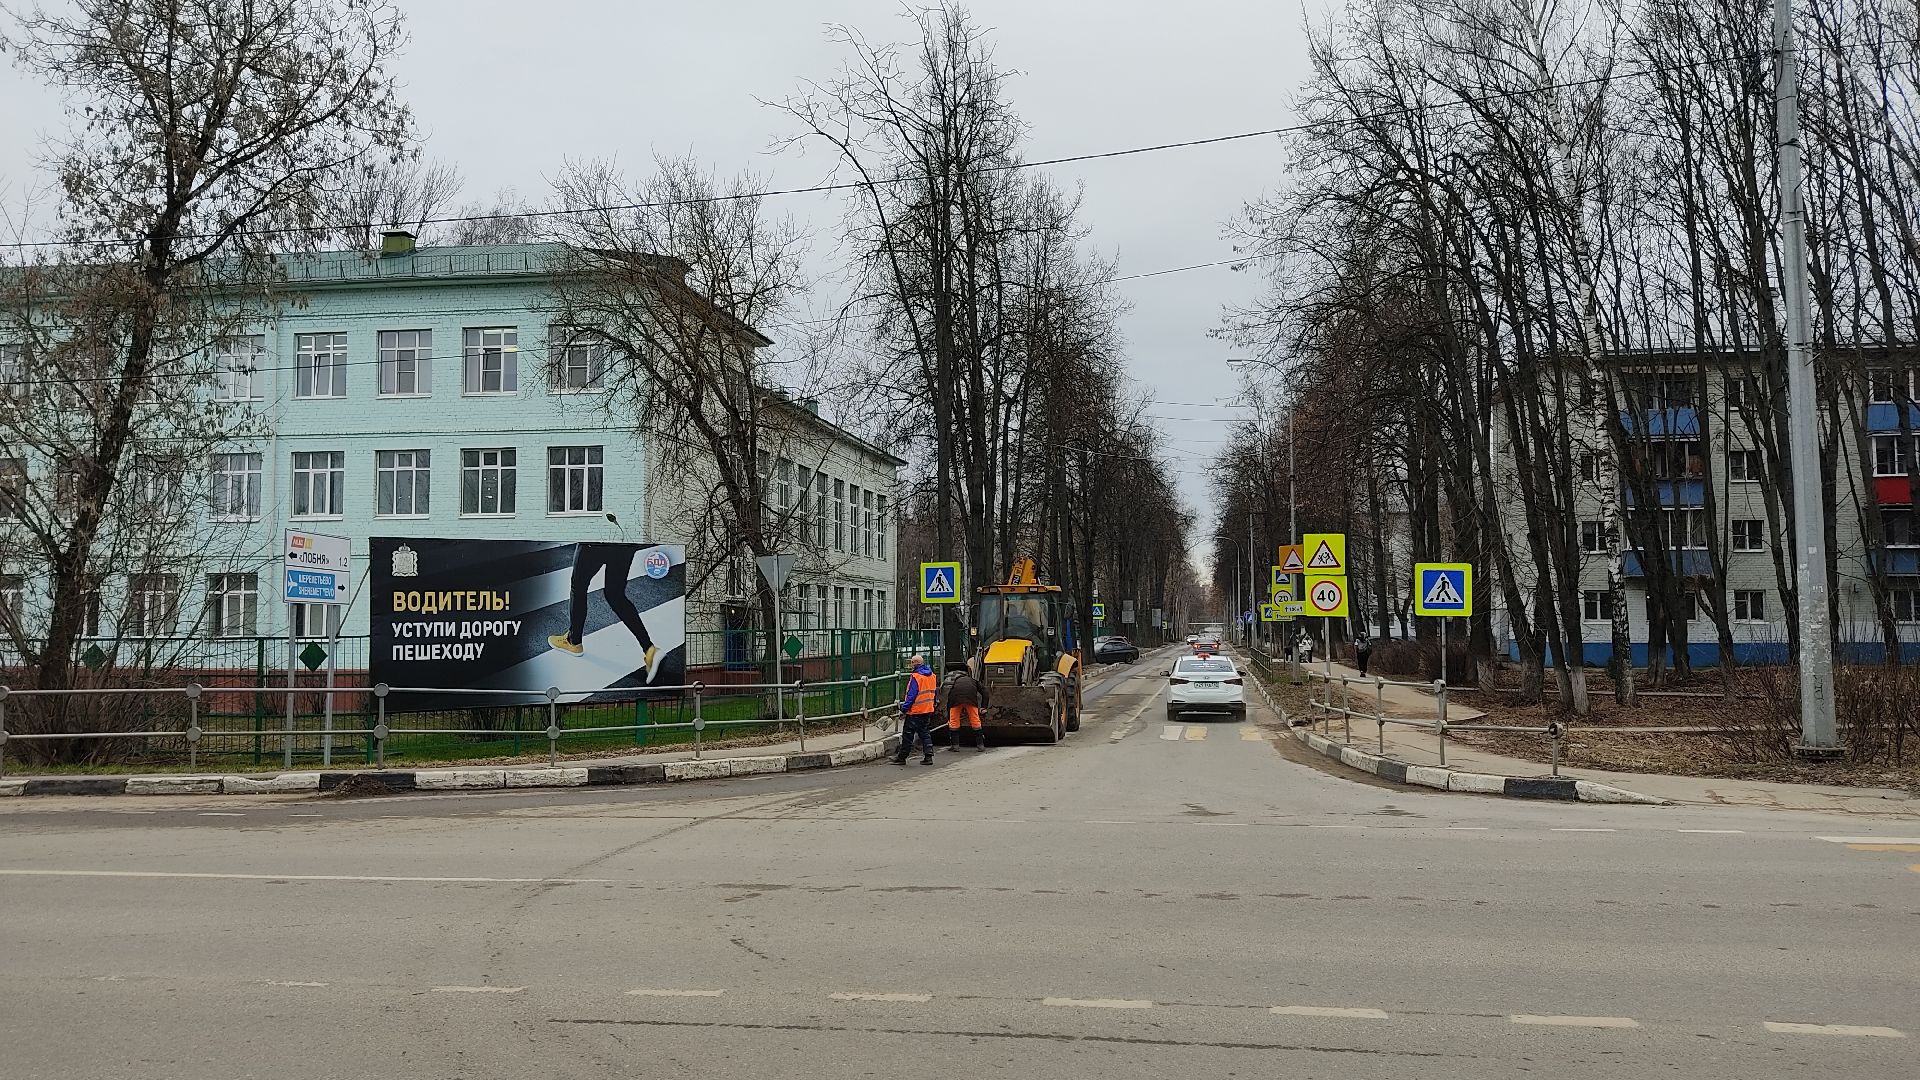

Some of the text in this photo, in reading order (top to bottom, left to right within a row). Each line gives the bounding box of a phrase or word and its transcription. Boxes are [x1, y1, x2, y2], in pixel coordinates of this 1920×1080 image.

[393, 590, 510, 615] ВОДИТЕЛЬ!
[1317, 590, 1335, 602] 40
[391, 620, 522, 640] УСТУПИ ДОРОГУ
[392, 642, 485, 661] ПЕШЕХОДУ
